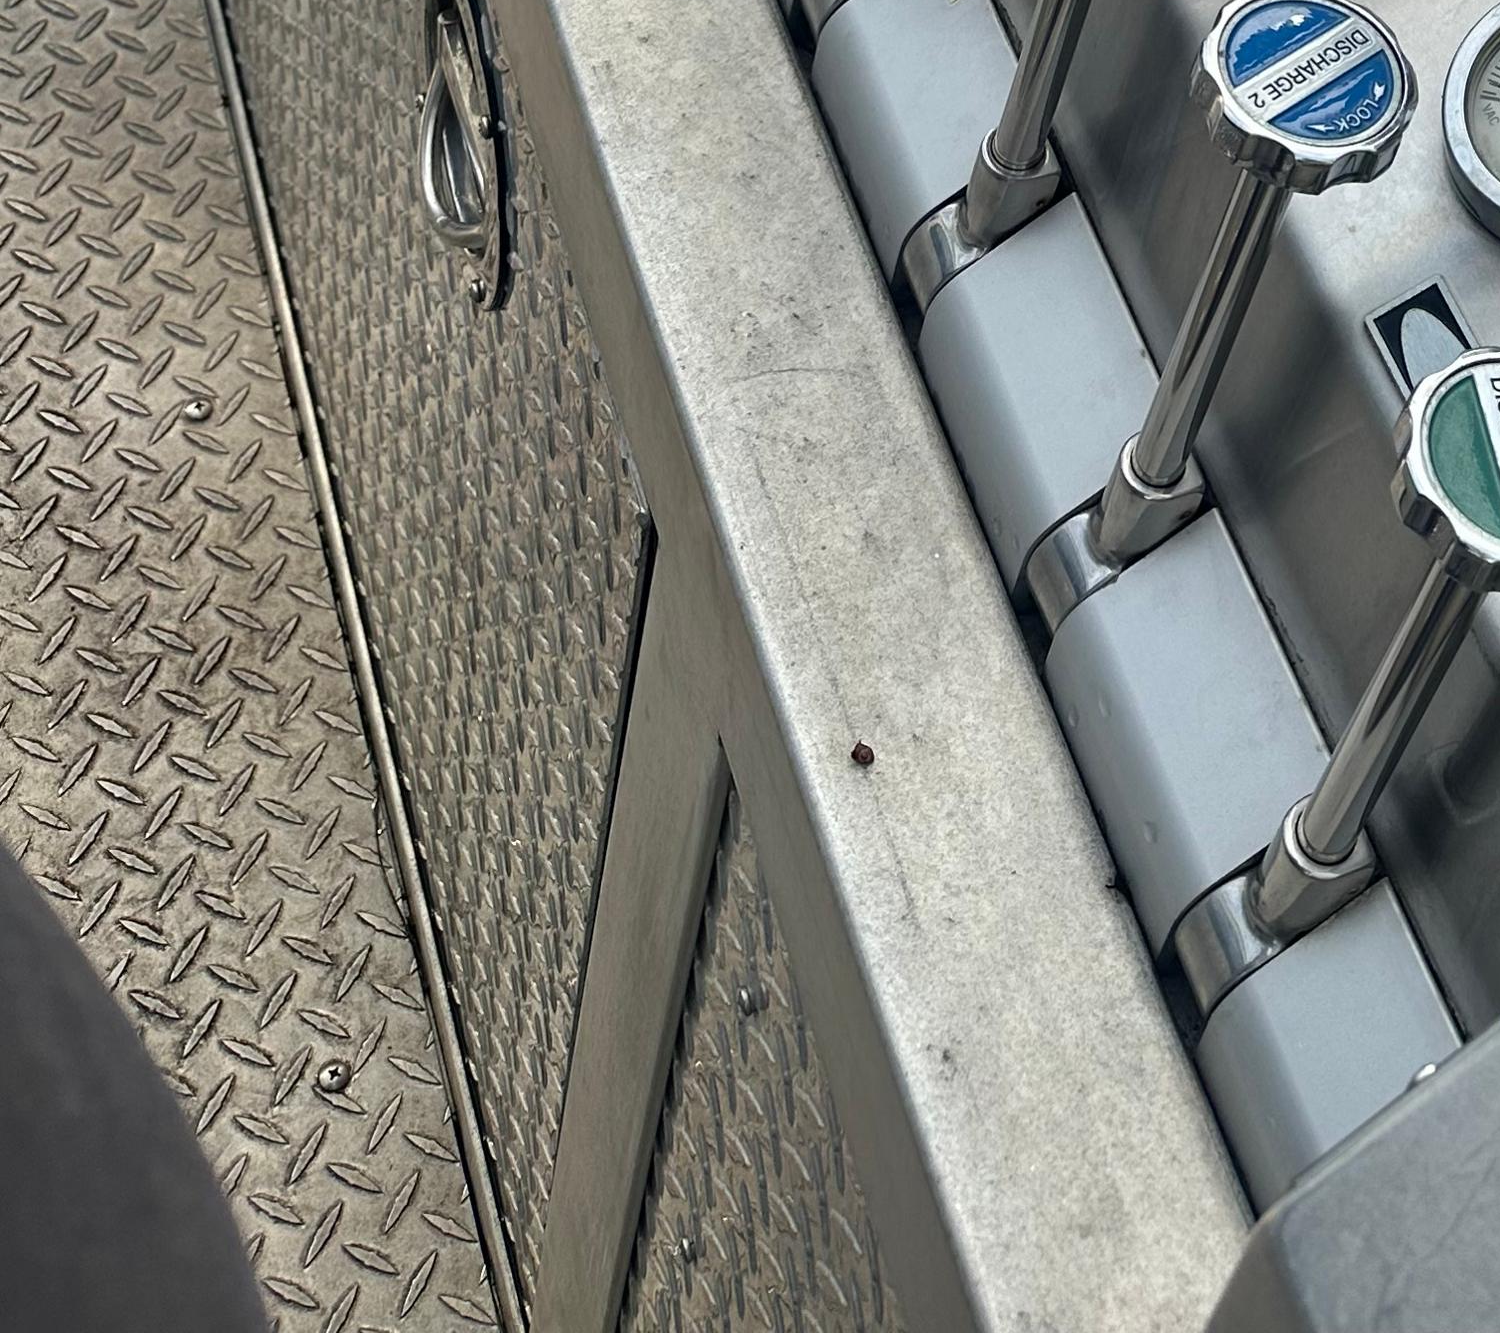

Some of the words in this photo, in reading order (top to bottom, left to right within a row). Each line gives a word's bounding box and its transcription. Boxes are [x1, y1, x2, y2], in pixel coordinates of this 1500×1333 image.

[1262, 29, 1370, 101] DISCHARGE
[1248, 94, 1266, 108] 2
[1333, 98, 1379, 132] LOCK
[1481, 103, 1500, 126] VAC
